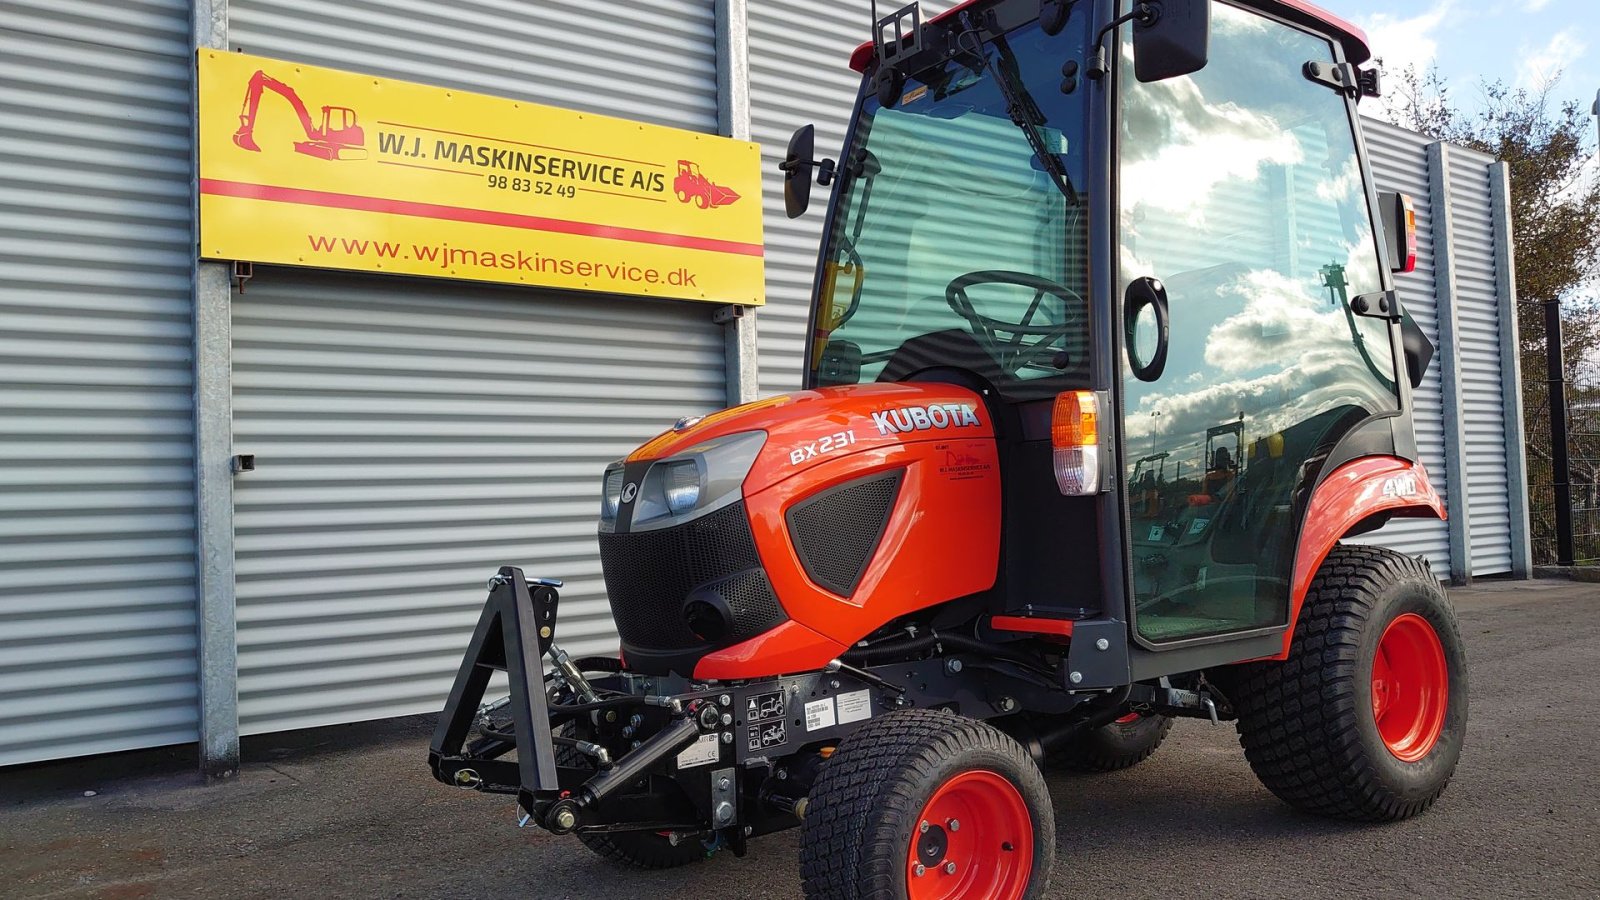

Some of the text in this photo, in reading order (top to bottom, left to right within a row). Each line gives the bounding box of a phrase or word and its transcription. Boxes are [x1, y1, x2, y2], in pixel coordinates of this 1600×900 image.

[378, 132, 665, 193] W.J. MASKINSERVICE A/S
[487, 174, 576, 199] 98 83 52 49
[307, 234, 697, 288] www.wjmaskinservice.dk
[871, 403, 981, 436] KUBOTA
[1382, 476, 1417, 497] 4WD
